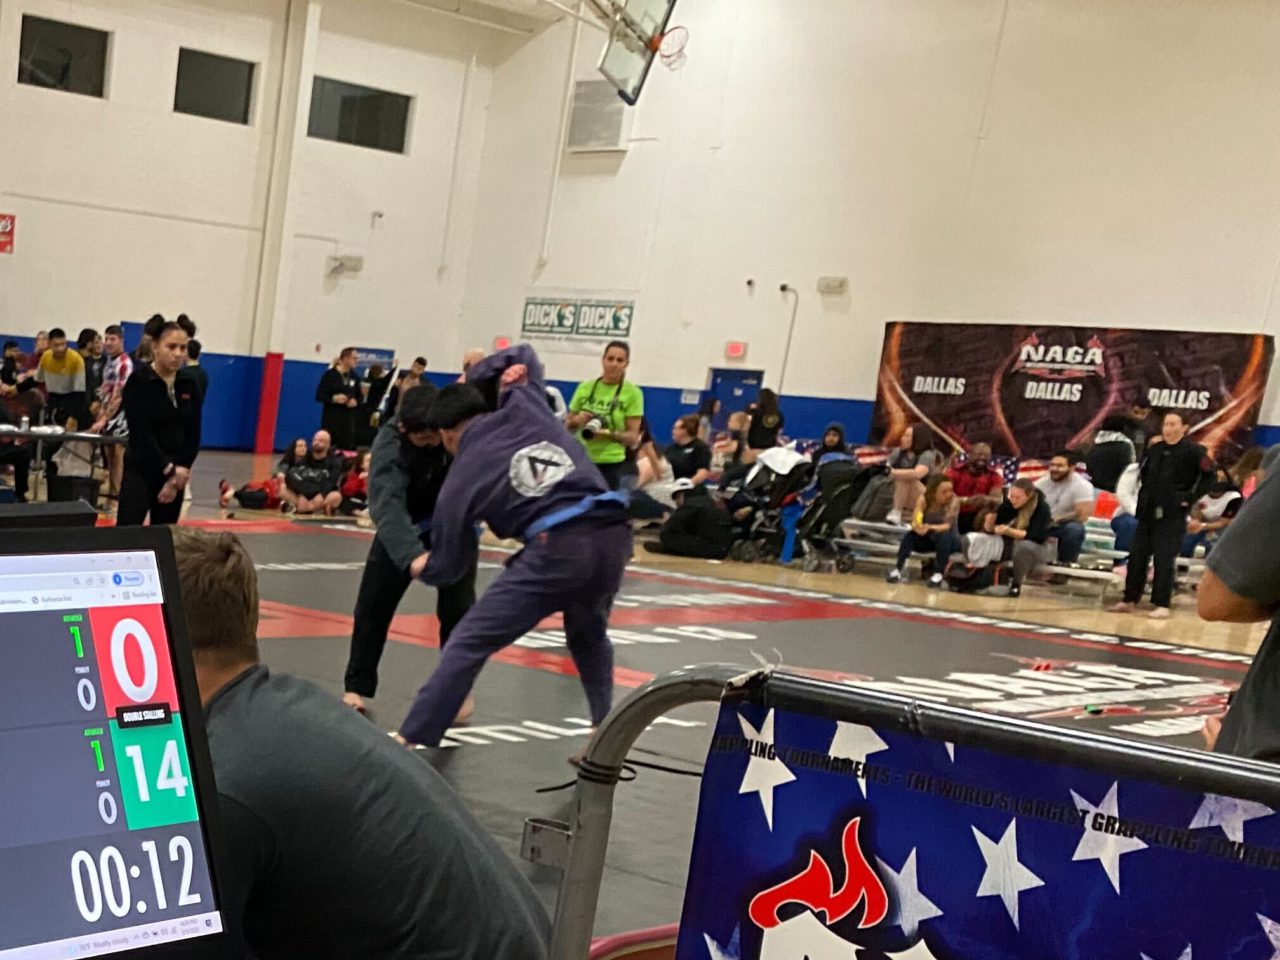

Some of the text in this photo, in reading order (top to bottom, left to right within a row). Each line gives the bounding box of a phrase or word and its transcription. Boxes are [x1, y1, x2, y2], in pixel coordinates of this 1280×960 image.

[1019, 344, 1103, 365] NAGA
[913, 376, 966, 395] DALLAS
[1024, 381, 1083, 402] DALLAS
[1147, 388, 1211, 410] DALLAS
[69, 626, 84, 658] 1
[110, 617, 159, 703] 0
[77, 678, 97, 711] 0
[91, 740, 104, 772] 1
[125, 739, 189, 803] 14
[98, 791, 118, 824] 0
[1091, 812, 1198, 850] GRAPPLING
[71, 835, 201, 923] 00:12
